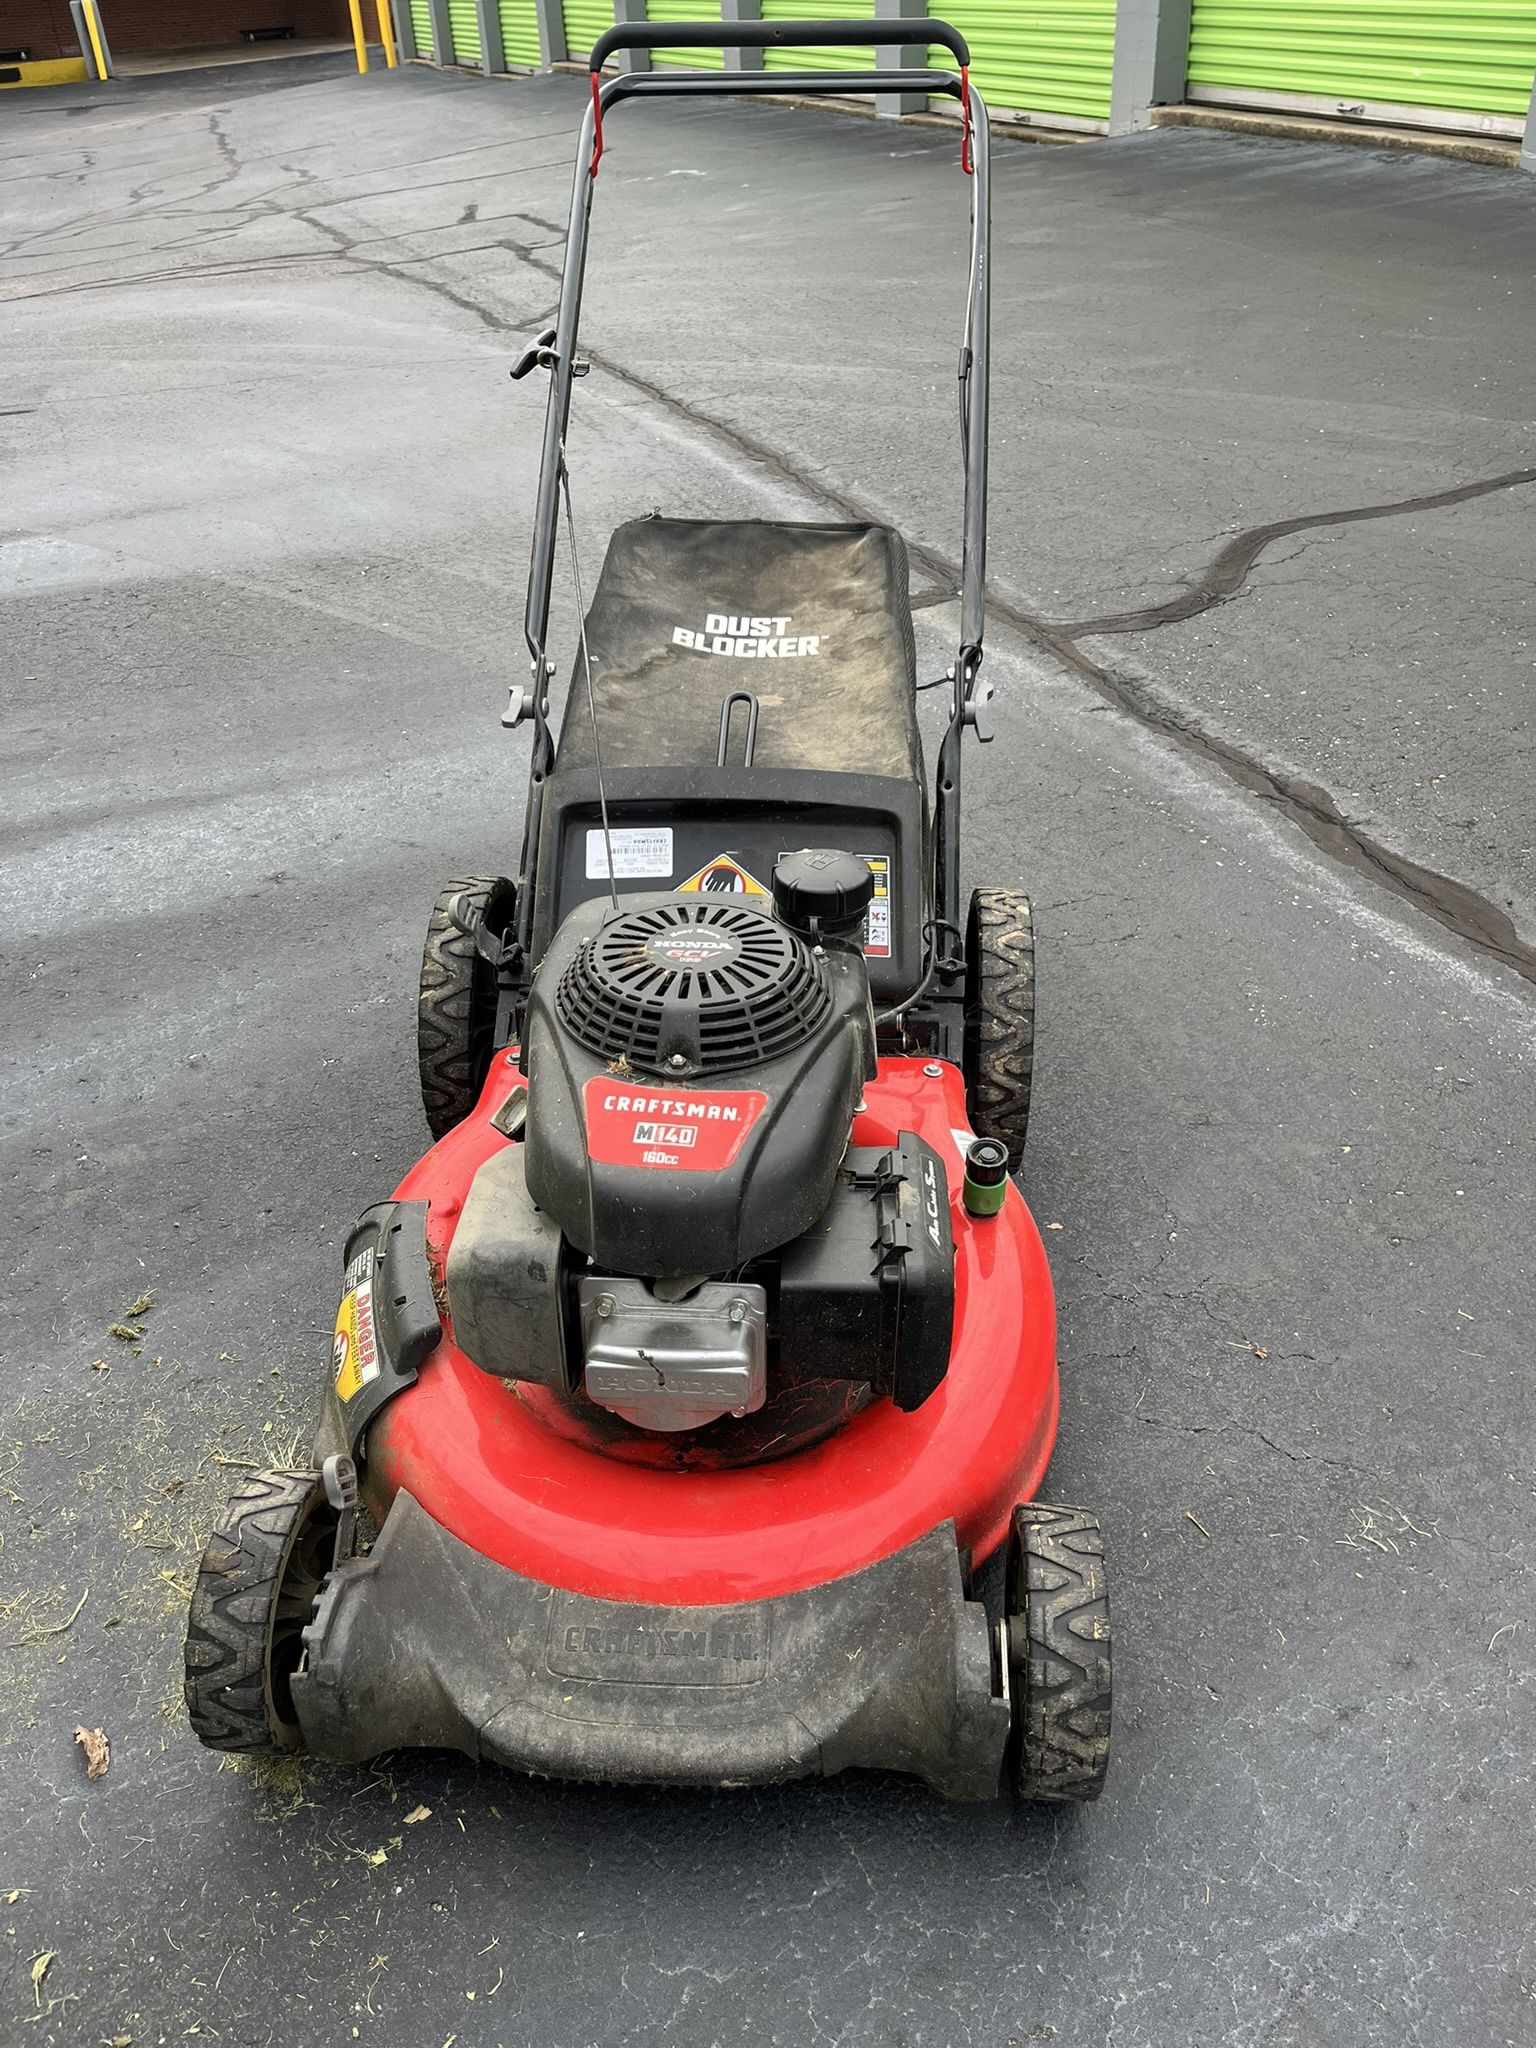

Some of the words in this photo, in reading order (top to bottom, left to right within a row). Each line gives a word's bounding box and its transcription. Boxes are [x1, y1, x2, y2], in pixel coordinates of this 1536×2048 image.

[705, 613, 792, 637] DUST
[671, 626, 821, 658] BLOCKER
[653, 940, 734, 950] HONDA
[665, 949, 722, 959] GCV
[604, 1095, 738, 1122] CRAFTSMAN
[637, 1125, 692, 1144] M140
[642, 1151, 679, 1166] 160cc
[925, 1160, 936, 1189] System
[927, 1190, 938, 1218] Choke
[928, 1219, 940, 1247] Auto
[357, 1294, 375, 1368] DANGER
[353, 1362, 361, 1385] AWAY
[598, 1376, 736, 1395] HONDA
[564, 1626, 754, 1660] CRAFTSMAN
